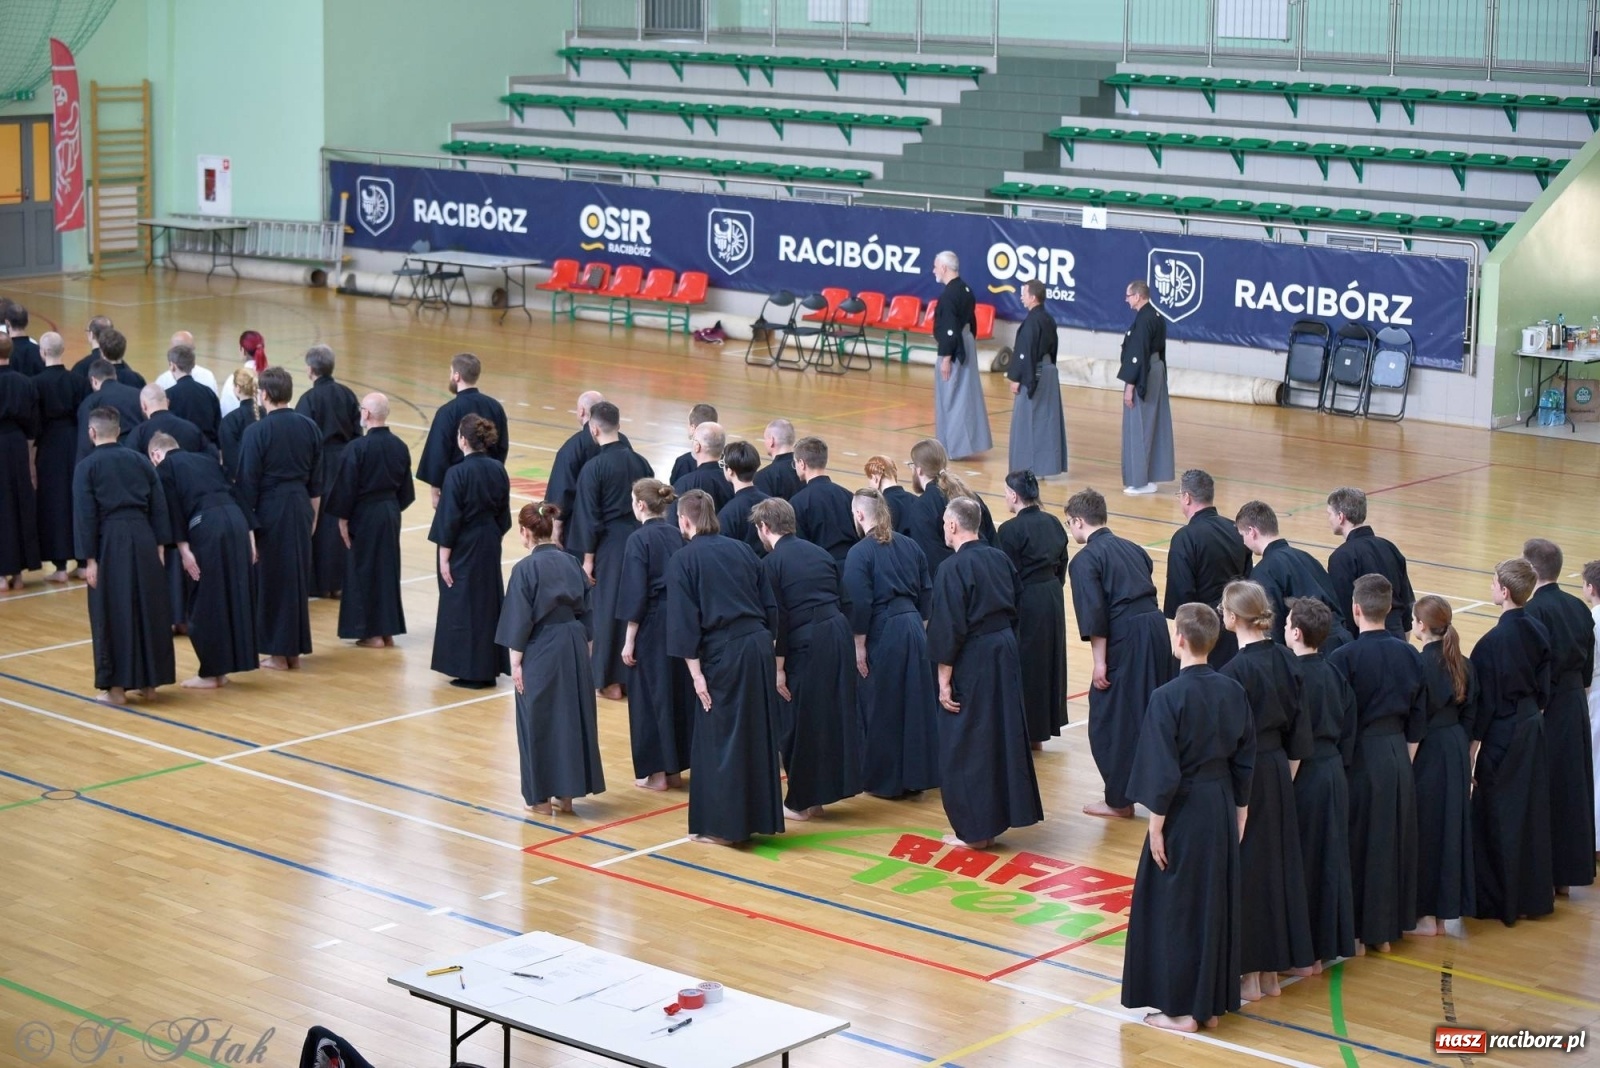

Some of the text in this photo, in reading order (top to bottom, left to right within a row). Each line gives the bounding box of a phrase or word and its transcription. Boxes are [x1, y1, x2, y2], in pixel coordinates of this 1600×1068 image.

[413, 197, 528, 234] RACIBÓRZ
[1090, 212, 1099, 225] A
[608, 242, 652, 258] RACIBÓRZ
[778, 234, 921, 274] RACIBÓRZ
[1234, 280, 1413, 326] RACIBÓRZ
